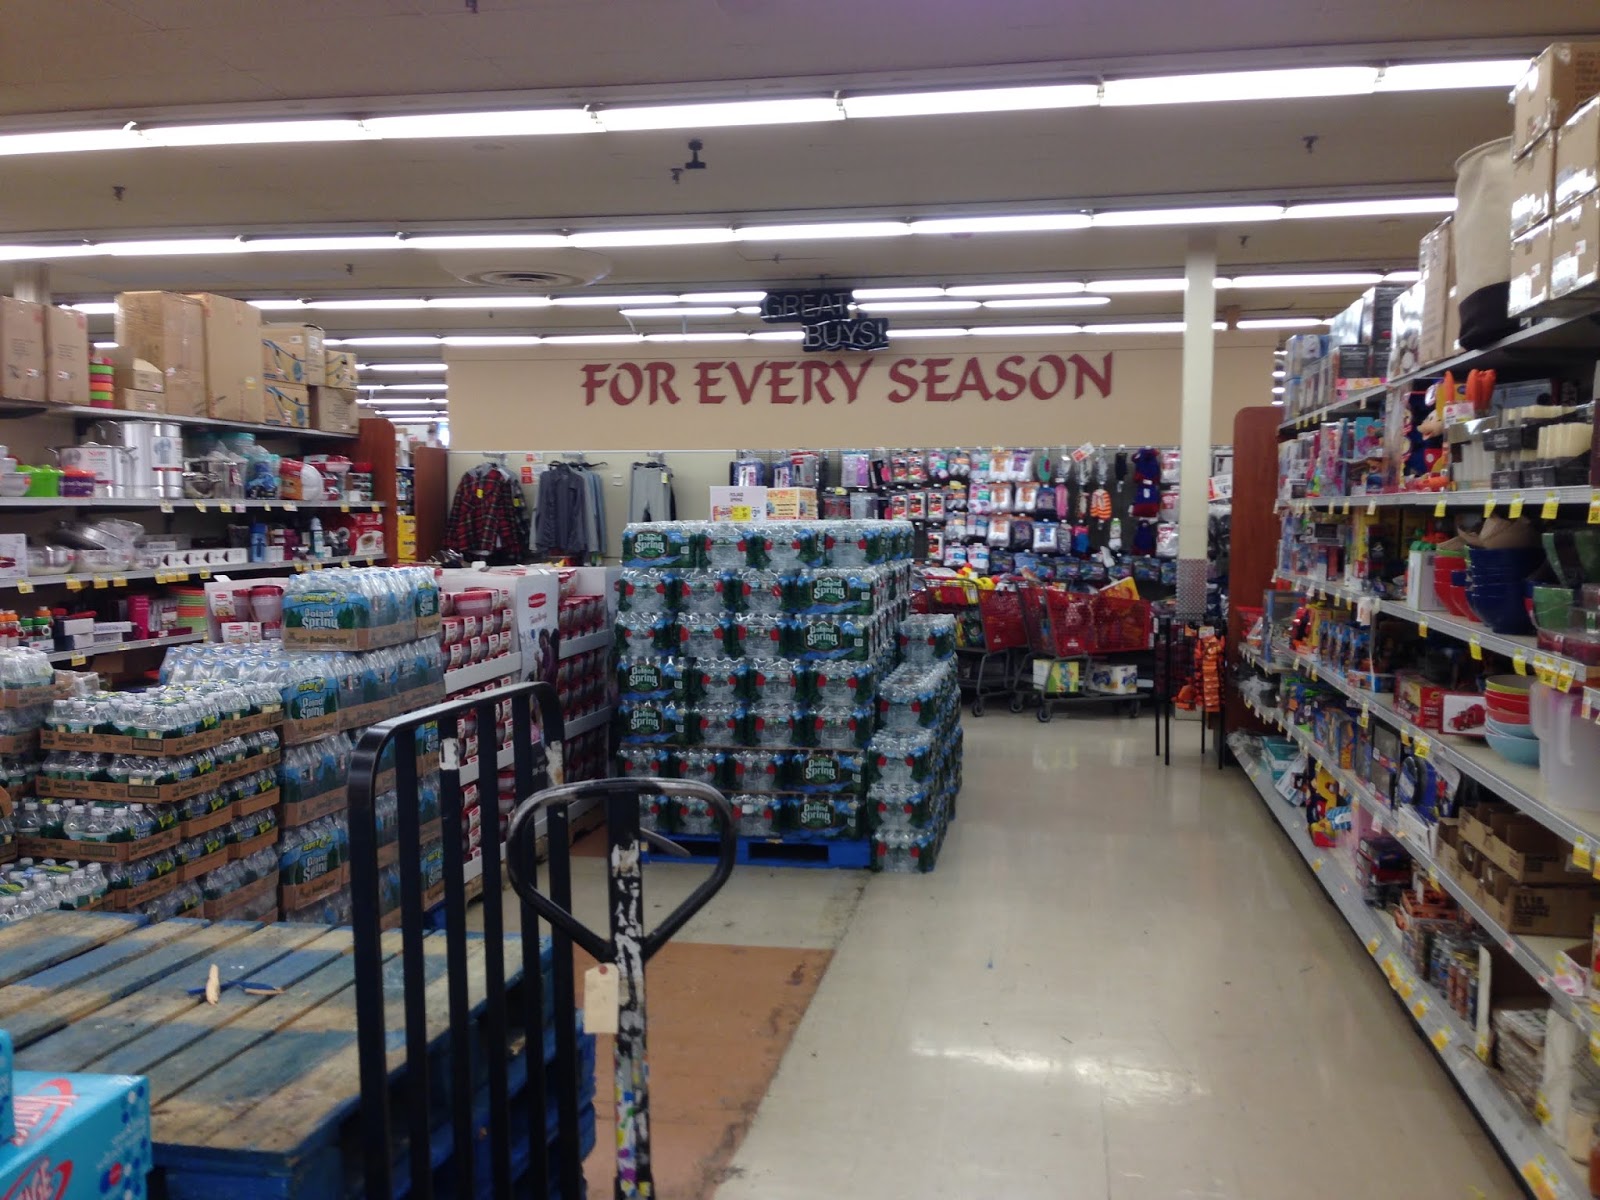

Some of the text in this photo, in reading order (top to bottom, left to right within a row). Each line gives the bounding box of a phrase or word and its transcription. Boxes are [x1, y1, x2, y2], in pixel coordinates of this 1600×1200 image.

[763, 292, 850, 318] GREAT
[804, 321, 885, 347] BUYS!
[580, 351, 1113, 406] FOR EVERY SEASON
[813, 586, 846, 600] Spring
[304, 608, 334, 618] Poland
[301, 617, 340, 630] Spring
[807, 632, 839, 646] Spring
[631, 666, 655, 675] Poland
[629, 674, 658, 687] Spring
[633, 710, 657, 719] Poland
[630, 717, 660, 730] Spring
[808, 759, 833, 768] Poland
[805, 766, 836, 780] Spring
[803, 803, 828, 812] Poland
[800, 810, 832, 825] Spring
